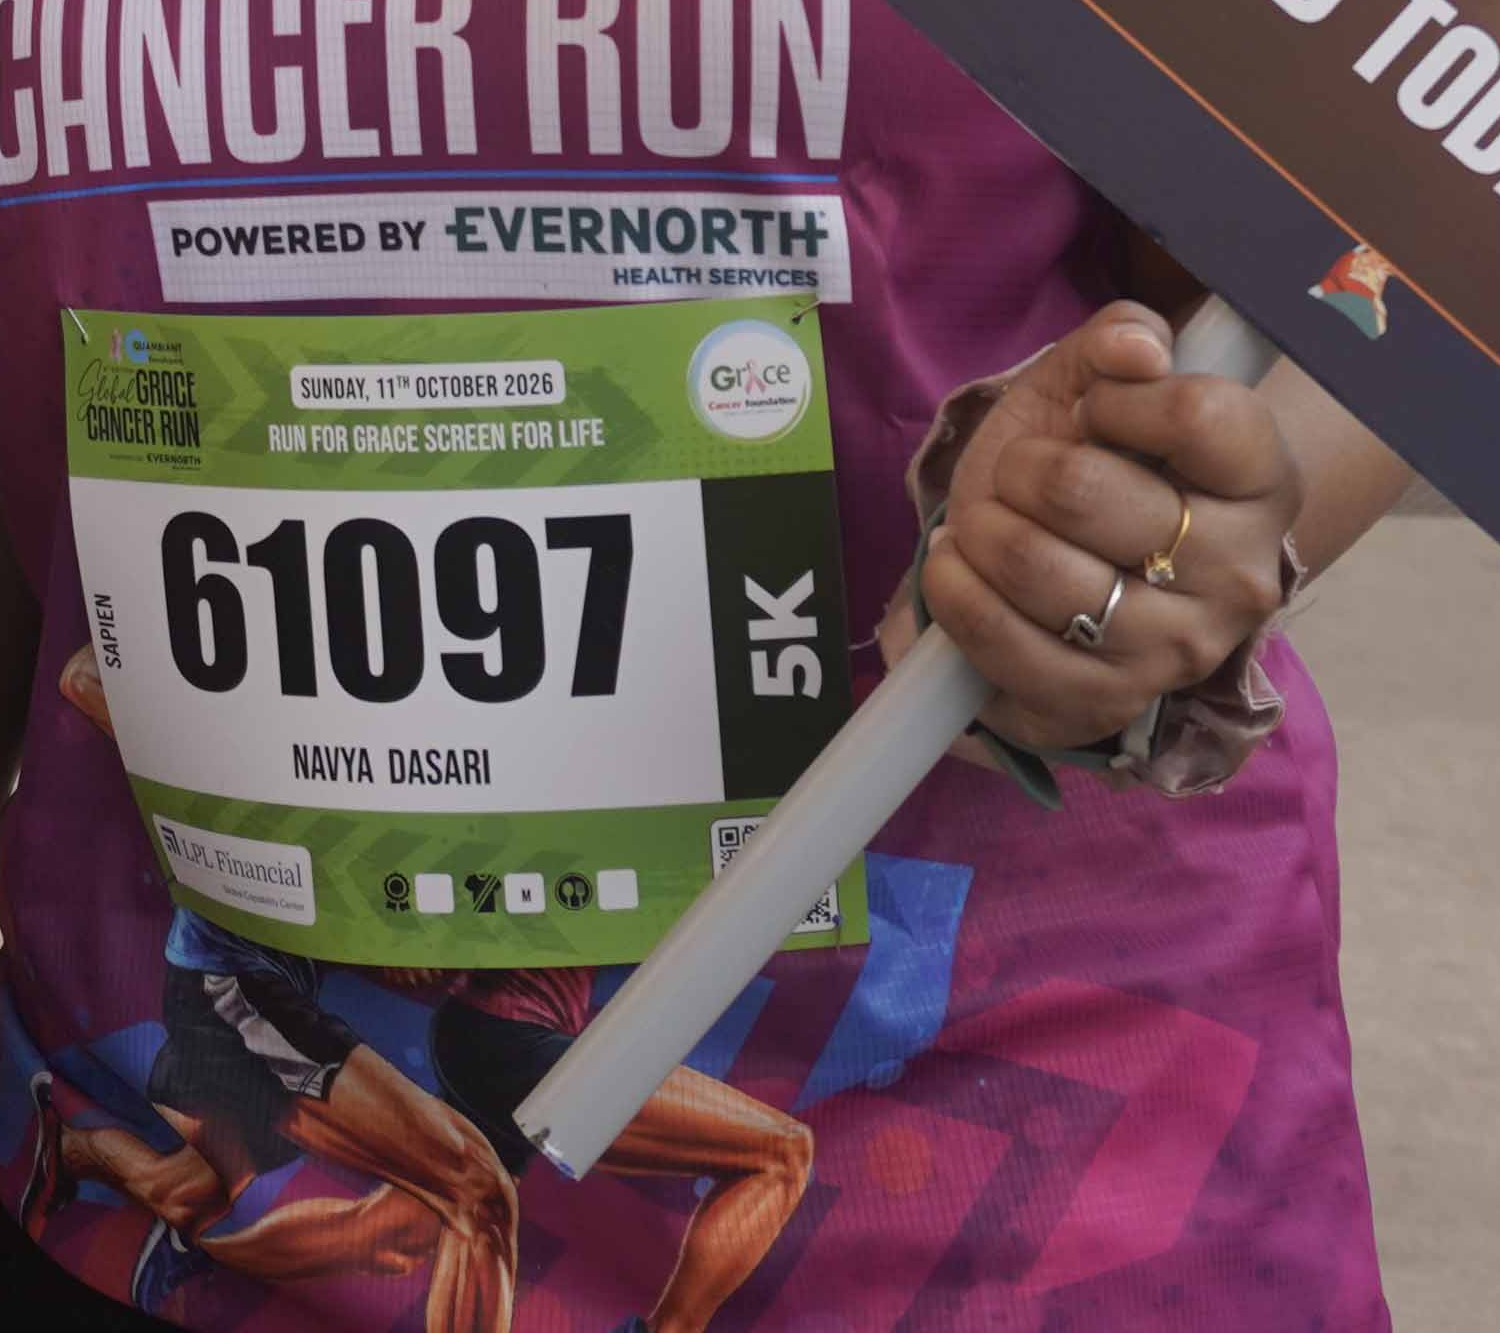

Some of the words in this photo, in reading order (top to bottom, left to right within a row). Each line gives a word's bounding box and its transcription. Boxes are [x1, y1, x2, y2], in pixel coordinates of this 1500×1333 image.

[170, 223, 366, 259] POWERED
[377, 220, 426, 253] BY
[446, 206, 829, 259] EVERNORTH
[612, 267, 703, 288] HEALTH
[708, 267, 819, 288] SERVICES
[136, 368, 197, 409] GRACE
[301, 377, 369, 402] SUNDAY,
[416, 374, 499, 398] OCTOBER
[504, 372, 554, 397] 2026
[87, 404, 157, 446] CANCER
[159, 409, 201, 449] RUN
[268, 424, 306, 453] RUN
[312, 425, 348, 453] FOR
[353, 425, 418, 453] GRACE
[423, 422, 506, 453] SCREEN
[512, 421, 554, 450] FOR
[559, 418, 605, 448] LIFE
[160, 510, 635, 704] 61097
[94, 593, 122, 670] SAPIEN
[744, 569, 822, 699] 5K
[293, 744, 374, 784] NAVYA
[388, 749, 491, 785] DASARI
[215, 850, 303, 887] Financial
[521, 888, 532, 903] M
